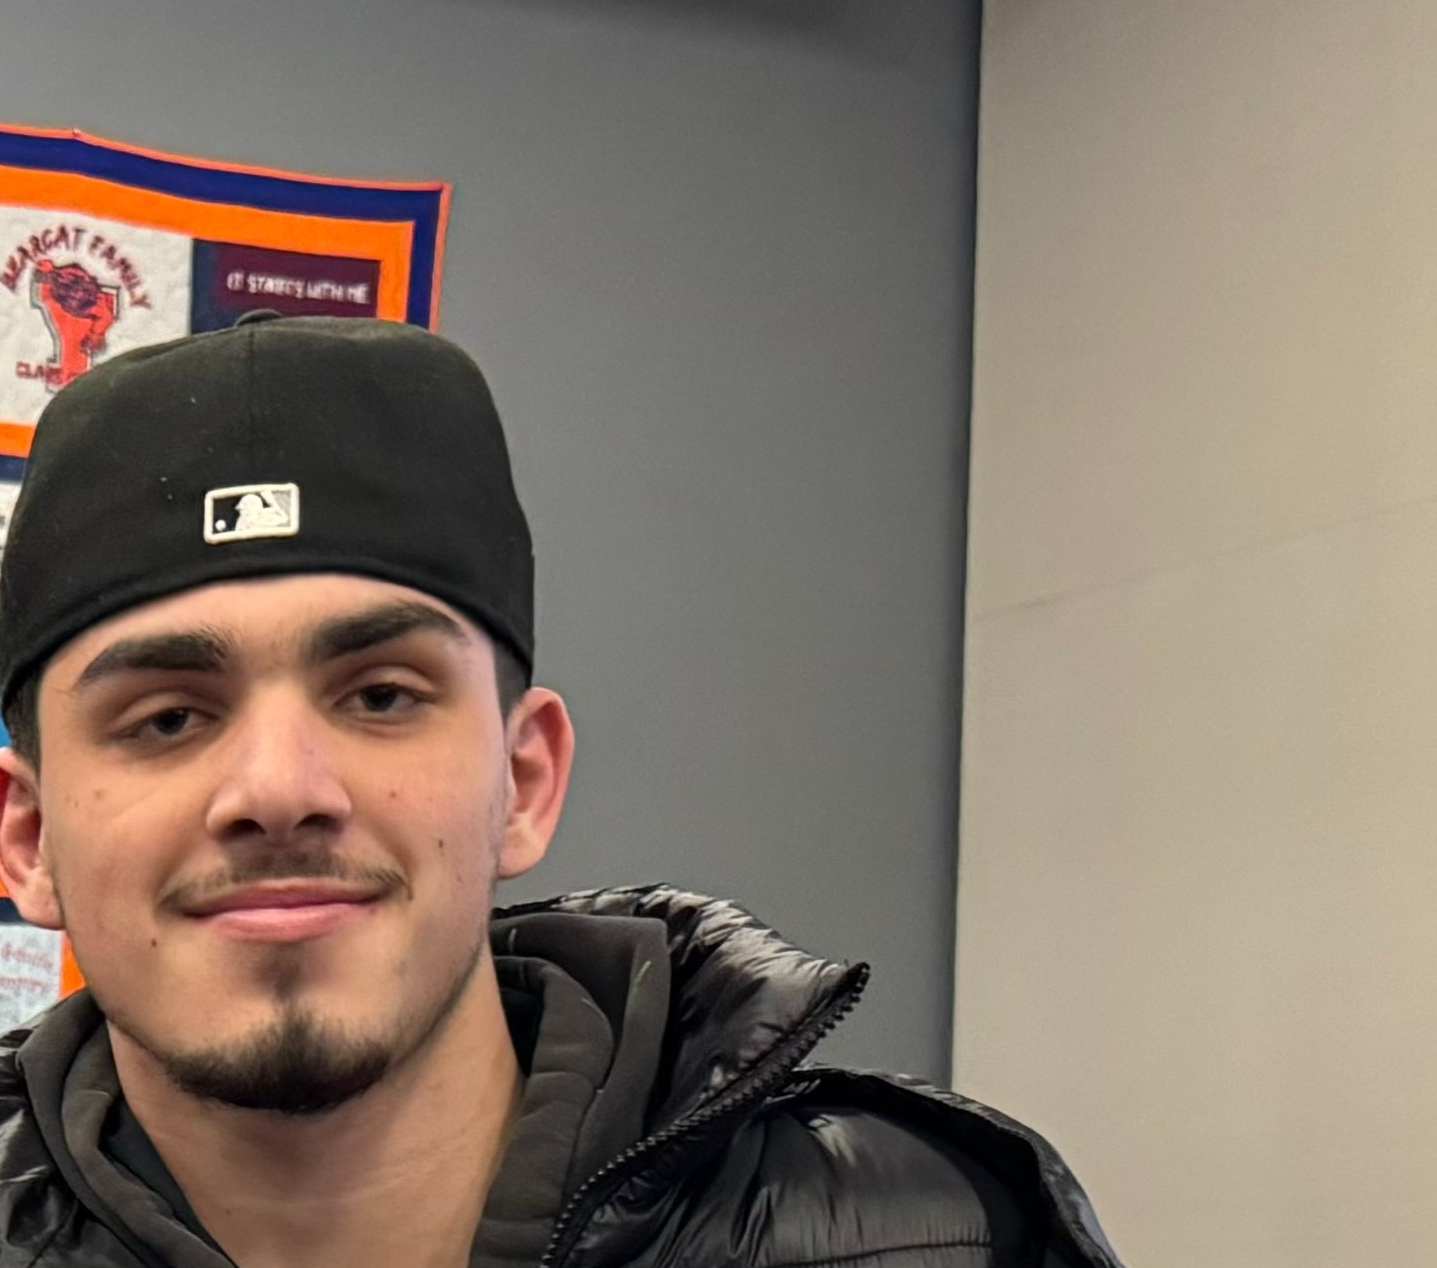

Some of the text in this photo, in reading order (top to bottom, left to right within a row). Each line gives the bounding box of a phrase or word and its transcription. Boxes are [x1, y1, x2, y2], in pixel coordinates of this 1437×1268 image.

[89, 235, 153, 310] FAMILY
[226, 272, 245, 291] IT
[247, 272, 305, 299] STARTS
[307, 280, 344, 301] WITH
